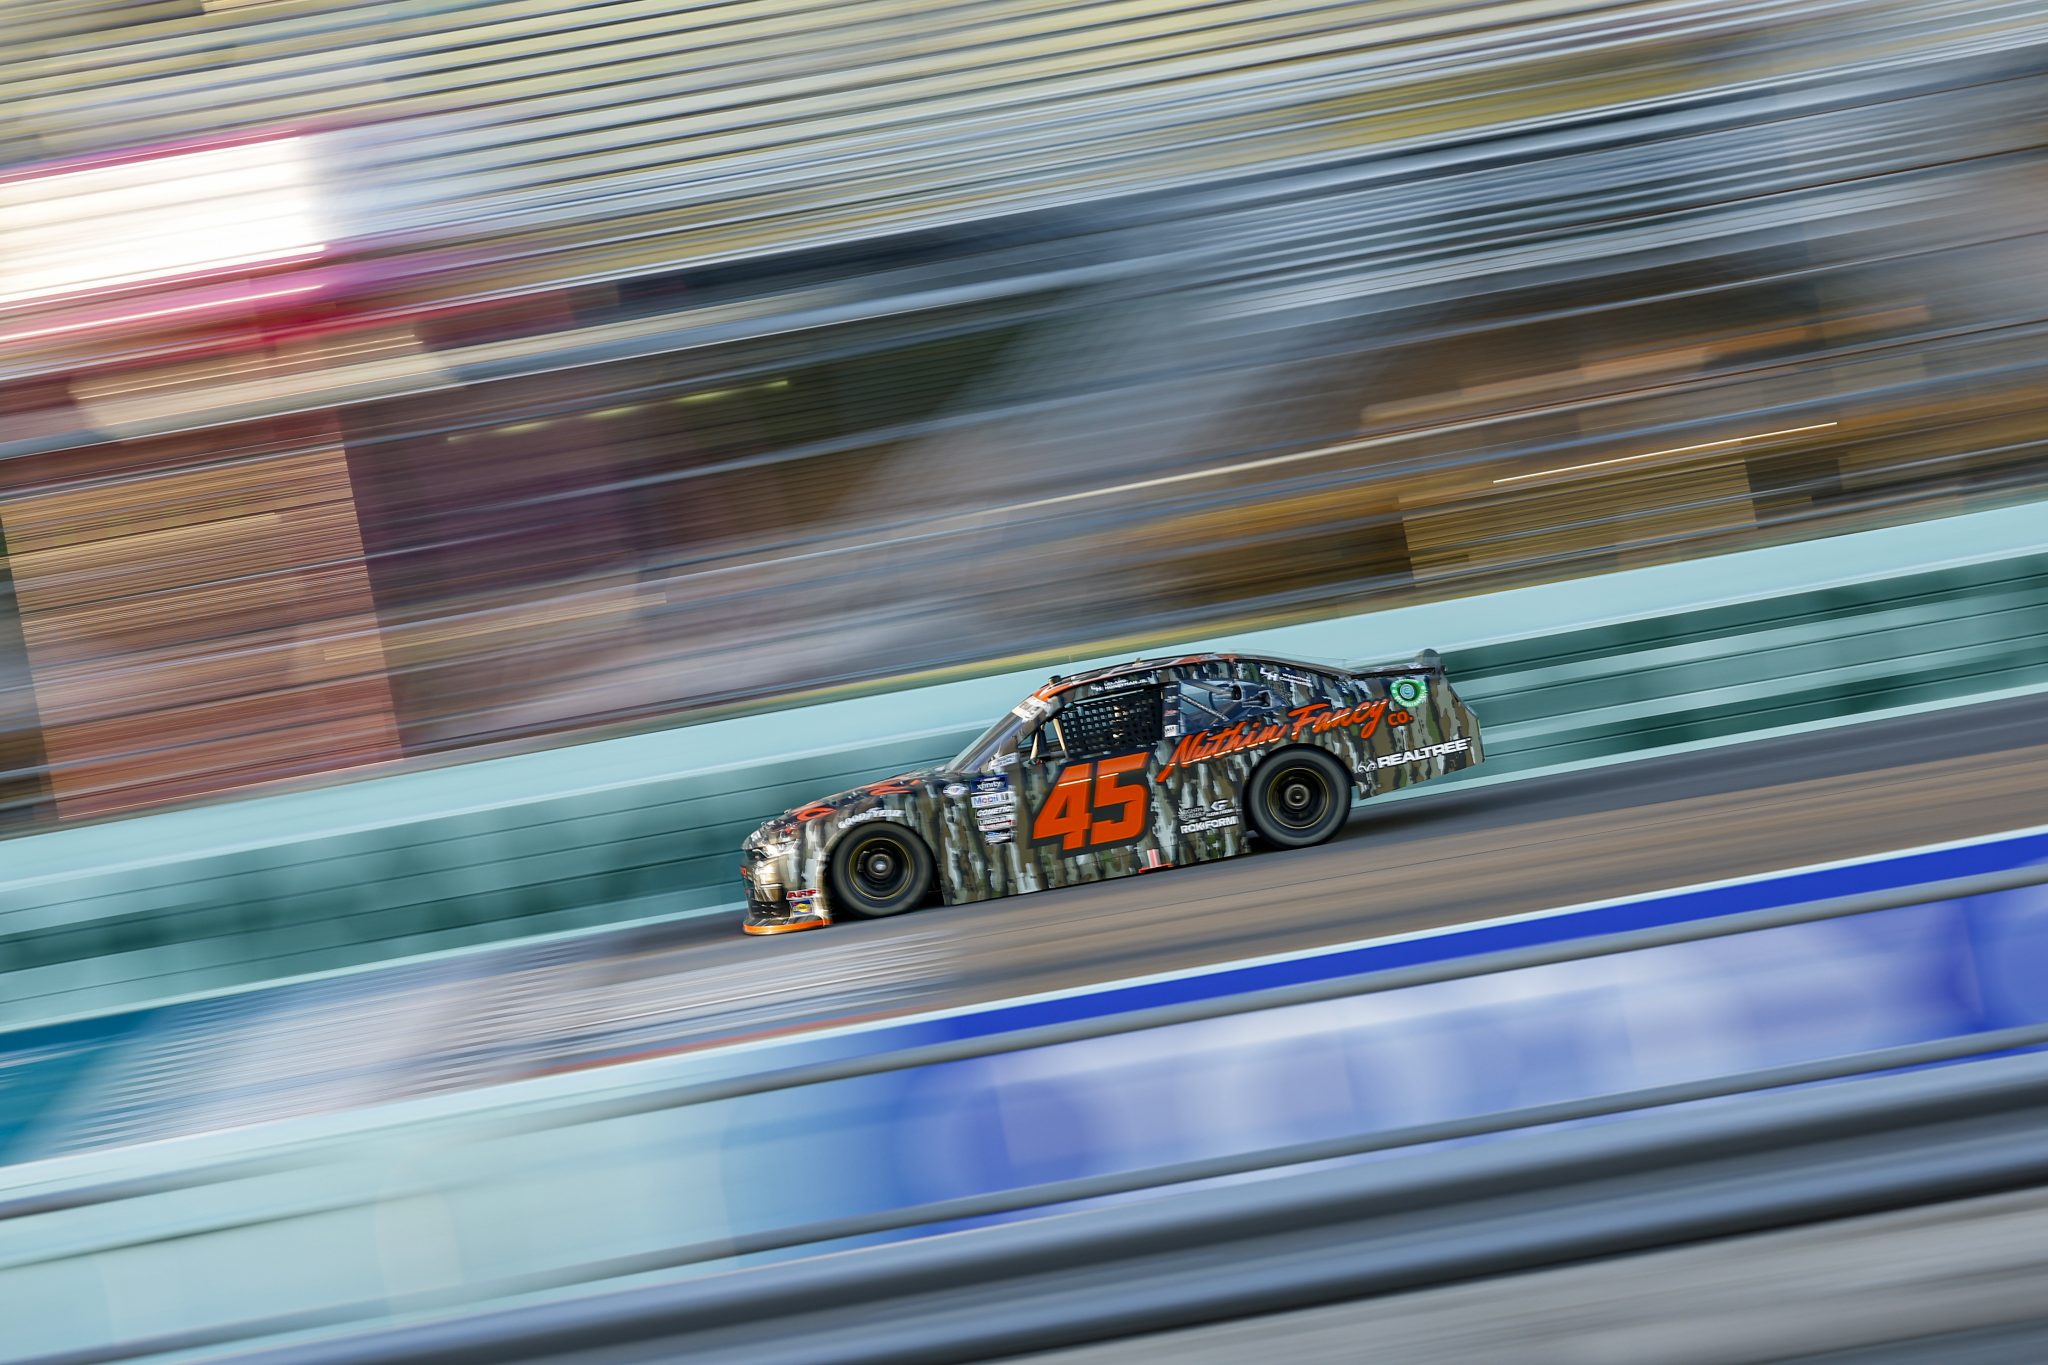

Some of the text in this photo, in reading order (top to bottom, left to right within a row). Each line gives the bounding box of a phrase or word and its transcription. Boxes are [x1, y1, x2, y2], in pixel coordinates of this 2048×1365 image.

[1287, 698, 1389, 741] Fancy
[1377, 739, 1471, 769] REALTREE
[976, 781, 1003, 791] xfinity
[1032, 751, 1150, 850] 45
[838, 808, 905, 829] GOODYEAR
